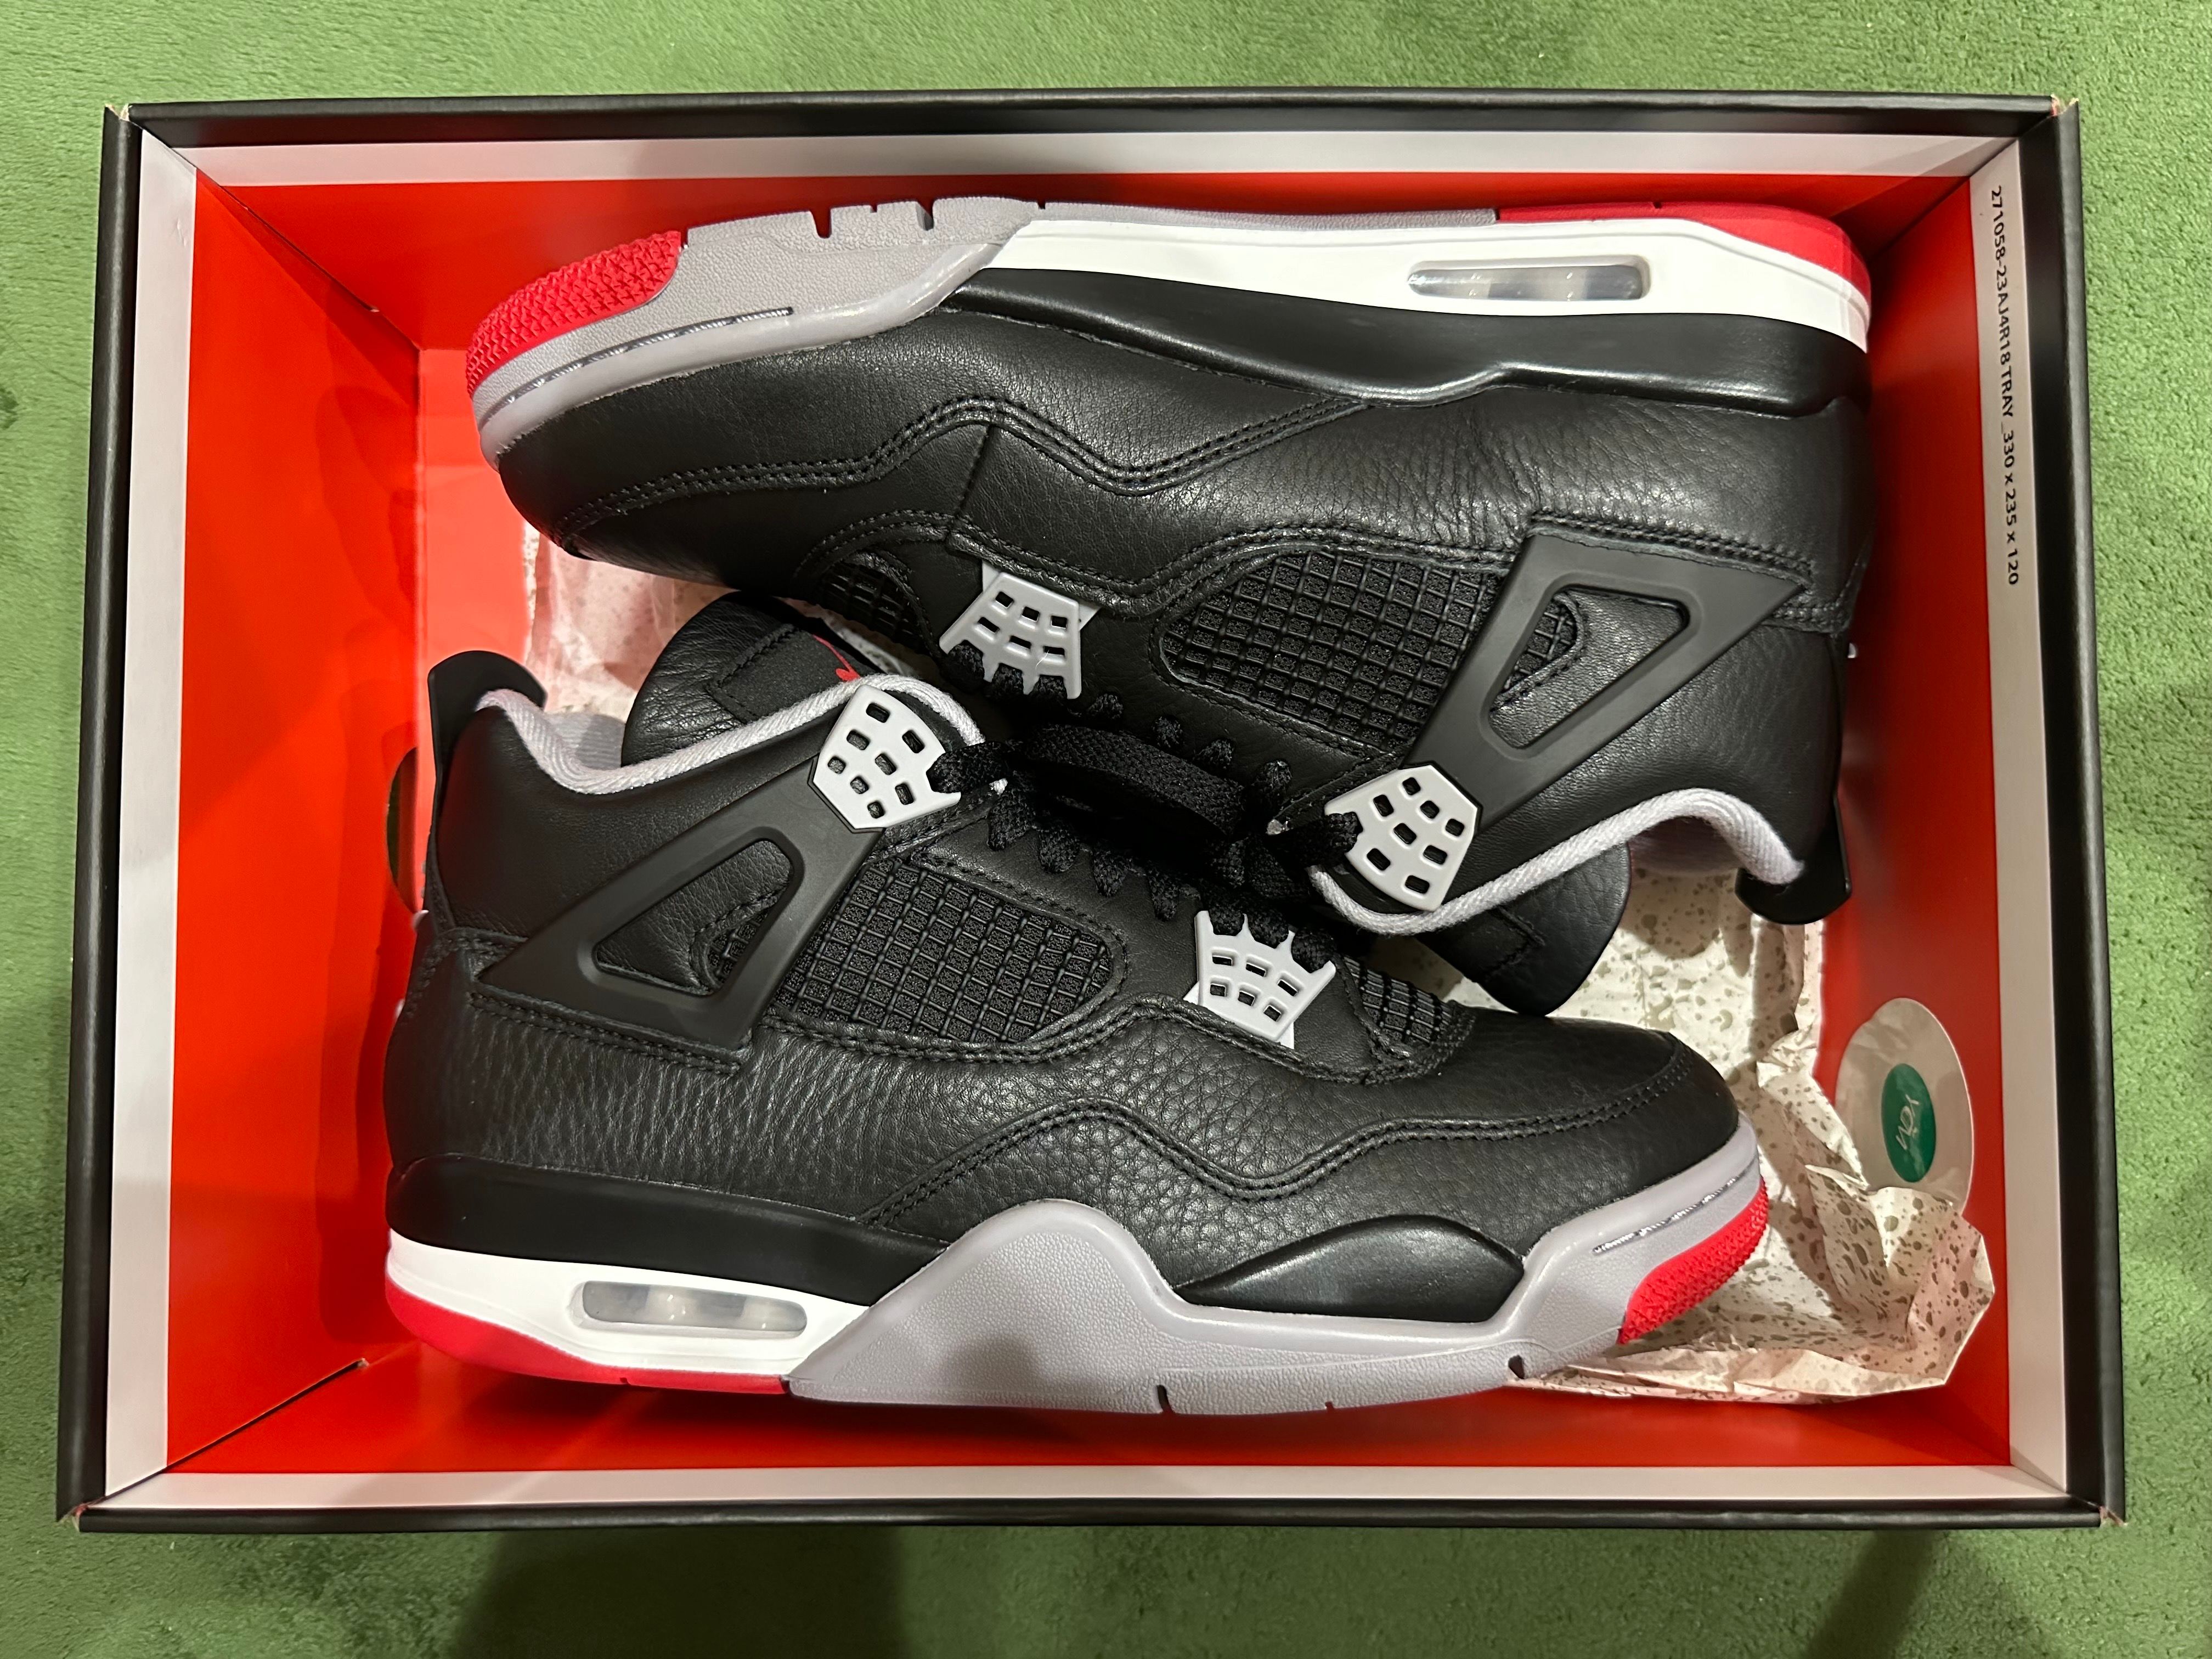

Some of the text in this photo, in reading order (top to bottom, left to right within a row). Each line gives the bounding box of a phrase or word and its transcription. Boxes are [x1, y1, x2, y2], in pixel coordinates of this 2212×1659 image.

[2001, 365, 2013, 417] TRAY
[2005, 488, 2016, 526] 235
[2007, 548, 2019, 585] 120
